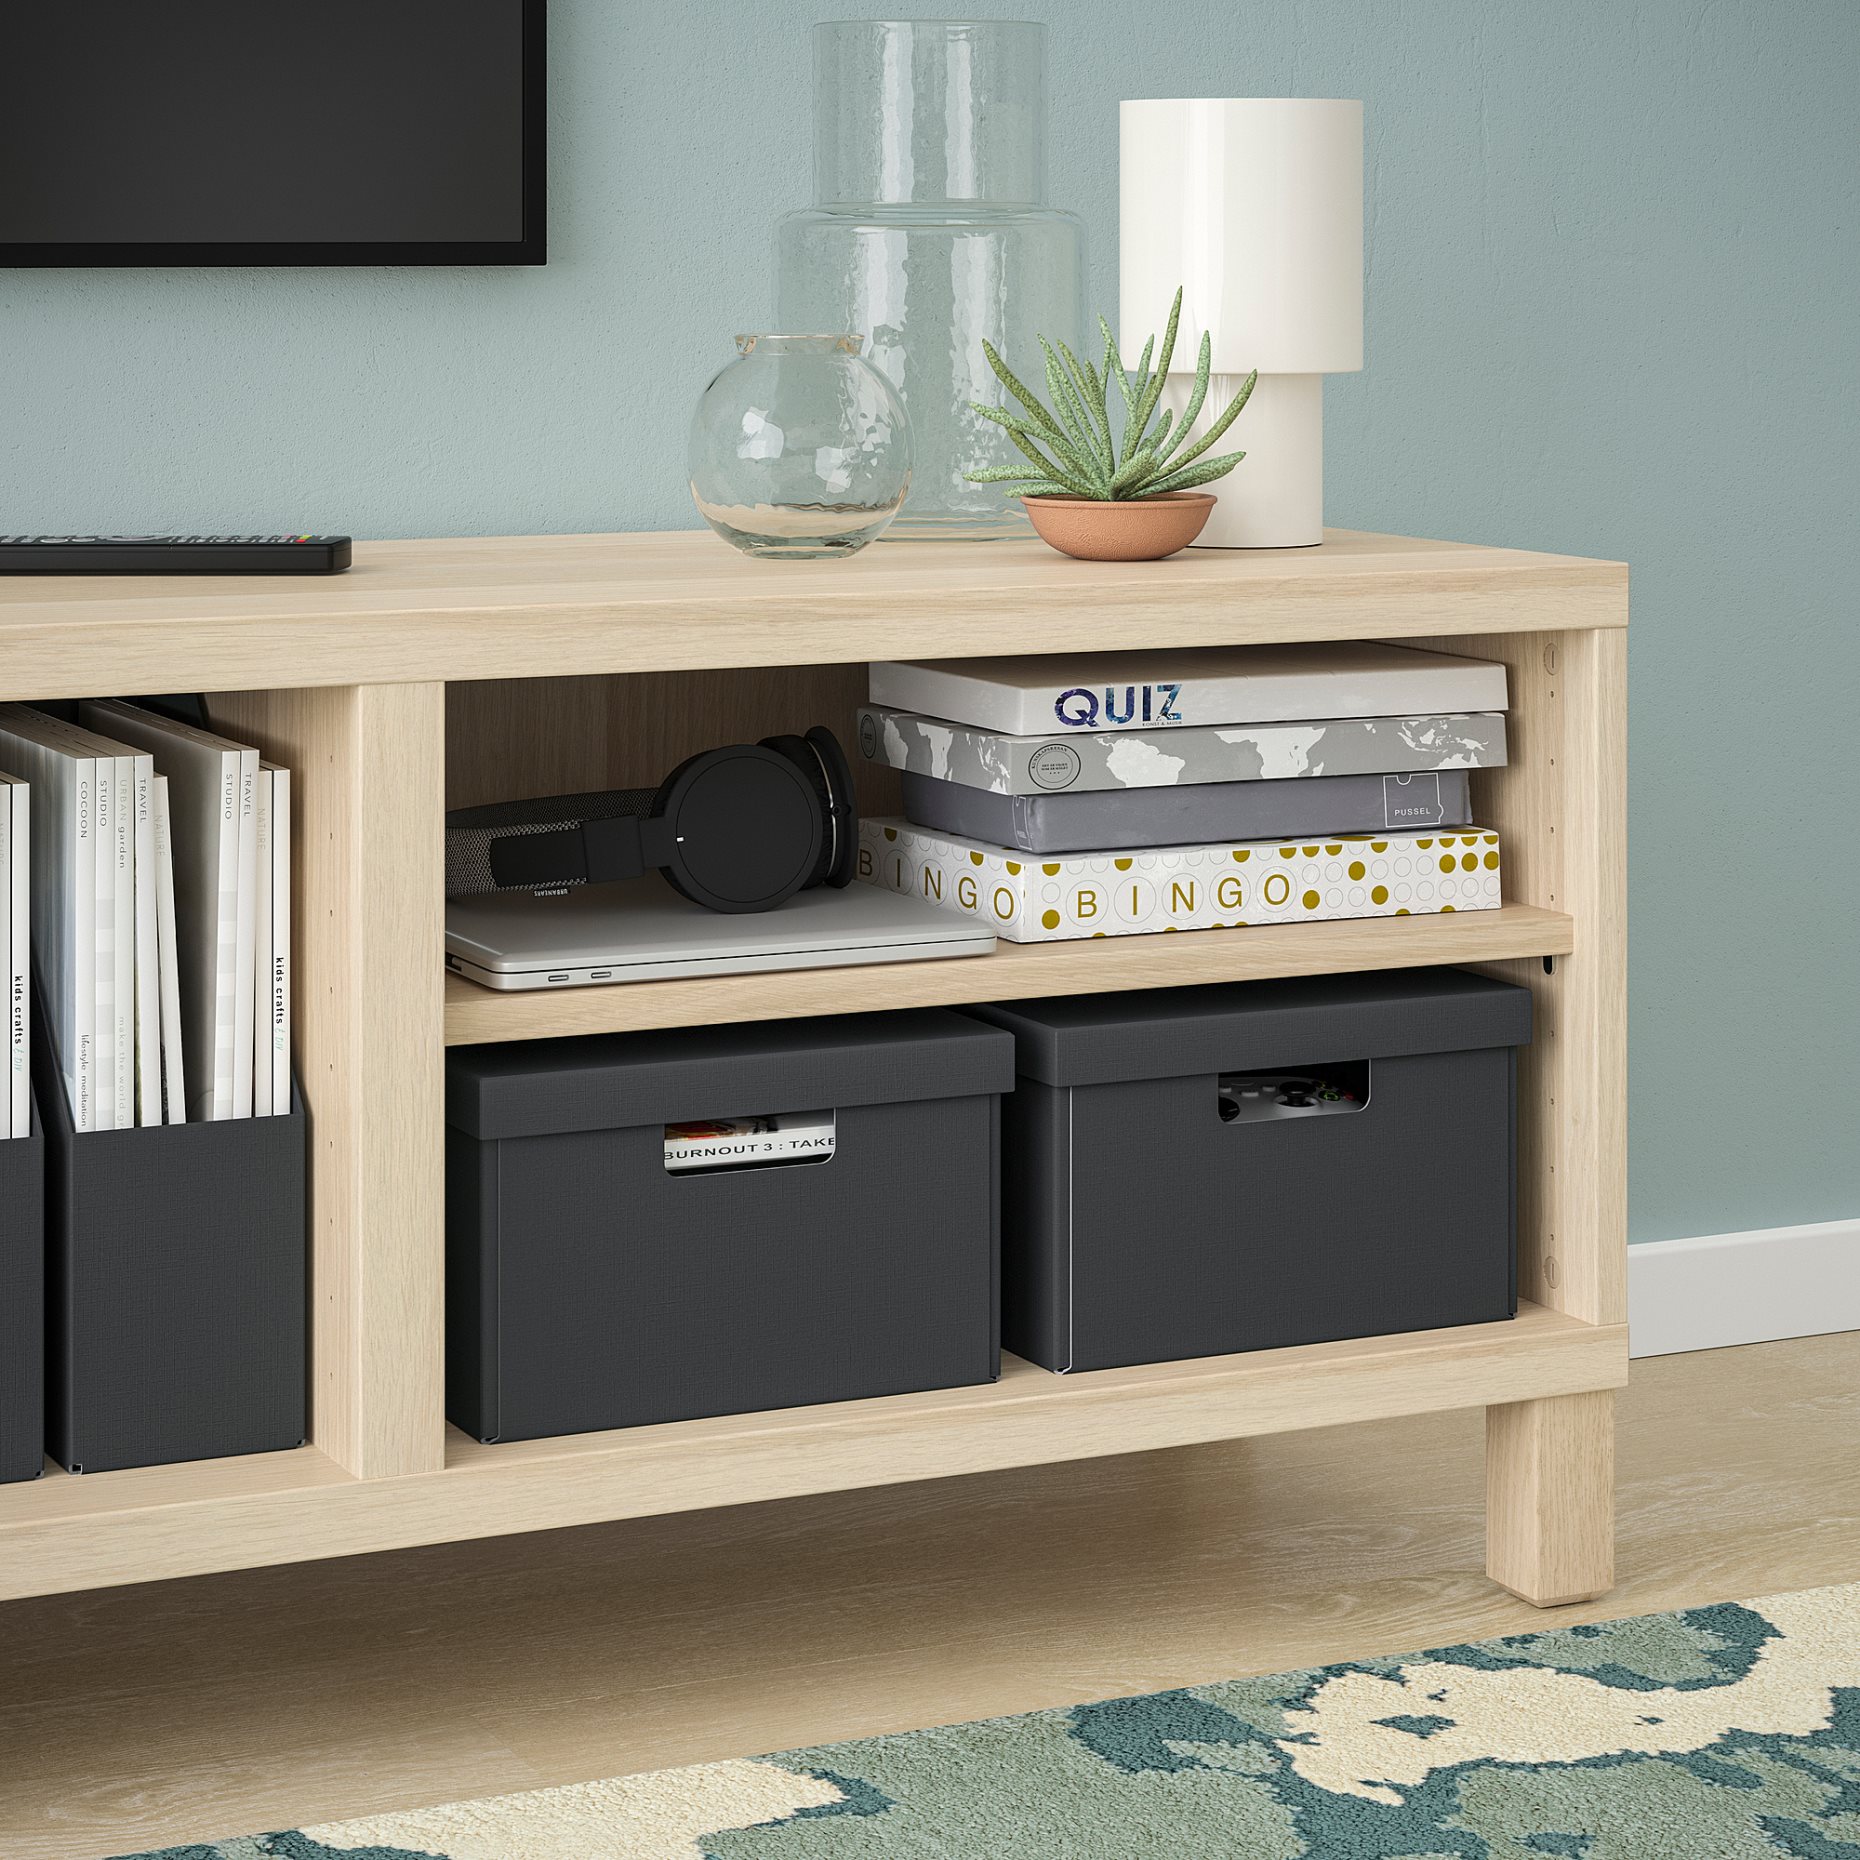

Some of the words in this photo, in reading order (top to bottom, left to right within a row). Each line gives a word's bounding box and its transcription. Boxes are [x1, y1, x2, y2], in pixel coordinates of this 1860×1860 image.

[1054, 684, 1182, 727] QUIZ
[80, 781, 88, 838] COCOON
[99, 780, 107, 827] STUDIO
[119, 779, 127, 822] URBAN
[139, 778, 147, 823] TRAVEL
[225, 774, 233, 820] STUDIO
[243, 773, 252, 817] TRAVEL
[1394, 807, 1431, 816] PUSSEL
[117, 826, 126, 869] garden
[859, 848, 1015, 920] BINGO
[1076, 874, 1292, 918] BINGO
[14, 975, 23, 1002] kids
[275, 957, 285, 982] kids
[14, 1007, 23, 1045] crafts
[275, 987, 285, 1024] crafts
[80, 1034, 90, 1071] lifestyle
[80, 1075, 89, 1127] meditation
[119, 1075, 127, 1109] world
[664, 1144, 758, 1160] BURNOUT
[763, 1142, 774, 1151] 3
